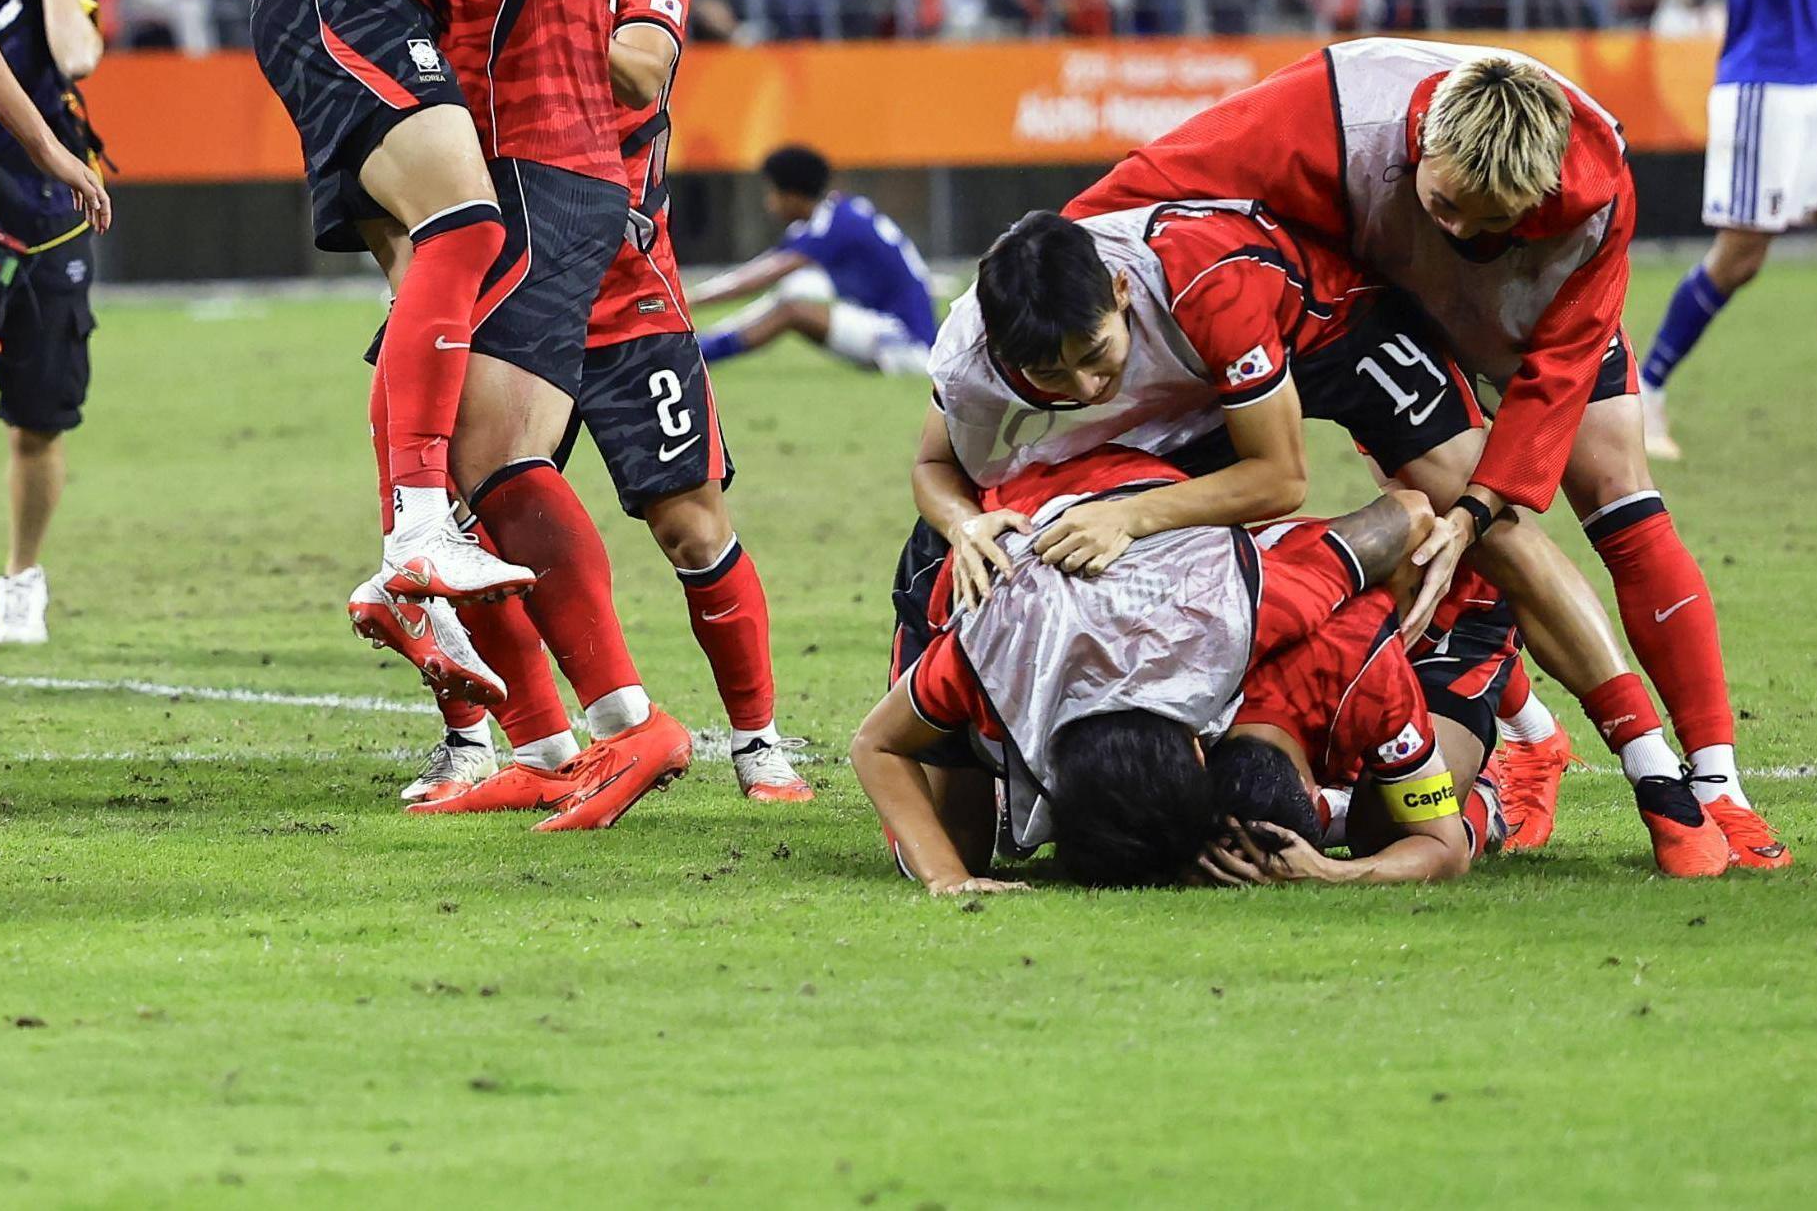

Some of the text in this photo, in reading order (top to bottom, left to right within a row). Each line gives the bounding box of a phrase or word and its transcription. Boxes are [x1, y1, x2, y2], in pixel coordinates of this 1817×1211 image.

[418, 74, 446, 83] KOREA
[648, 369, 692, 437] 2
[1356, 333, 1448, 416] 14
